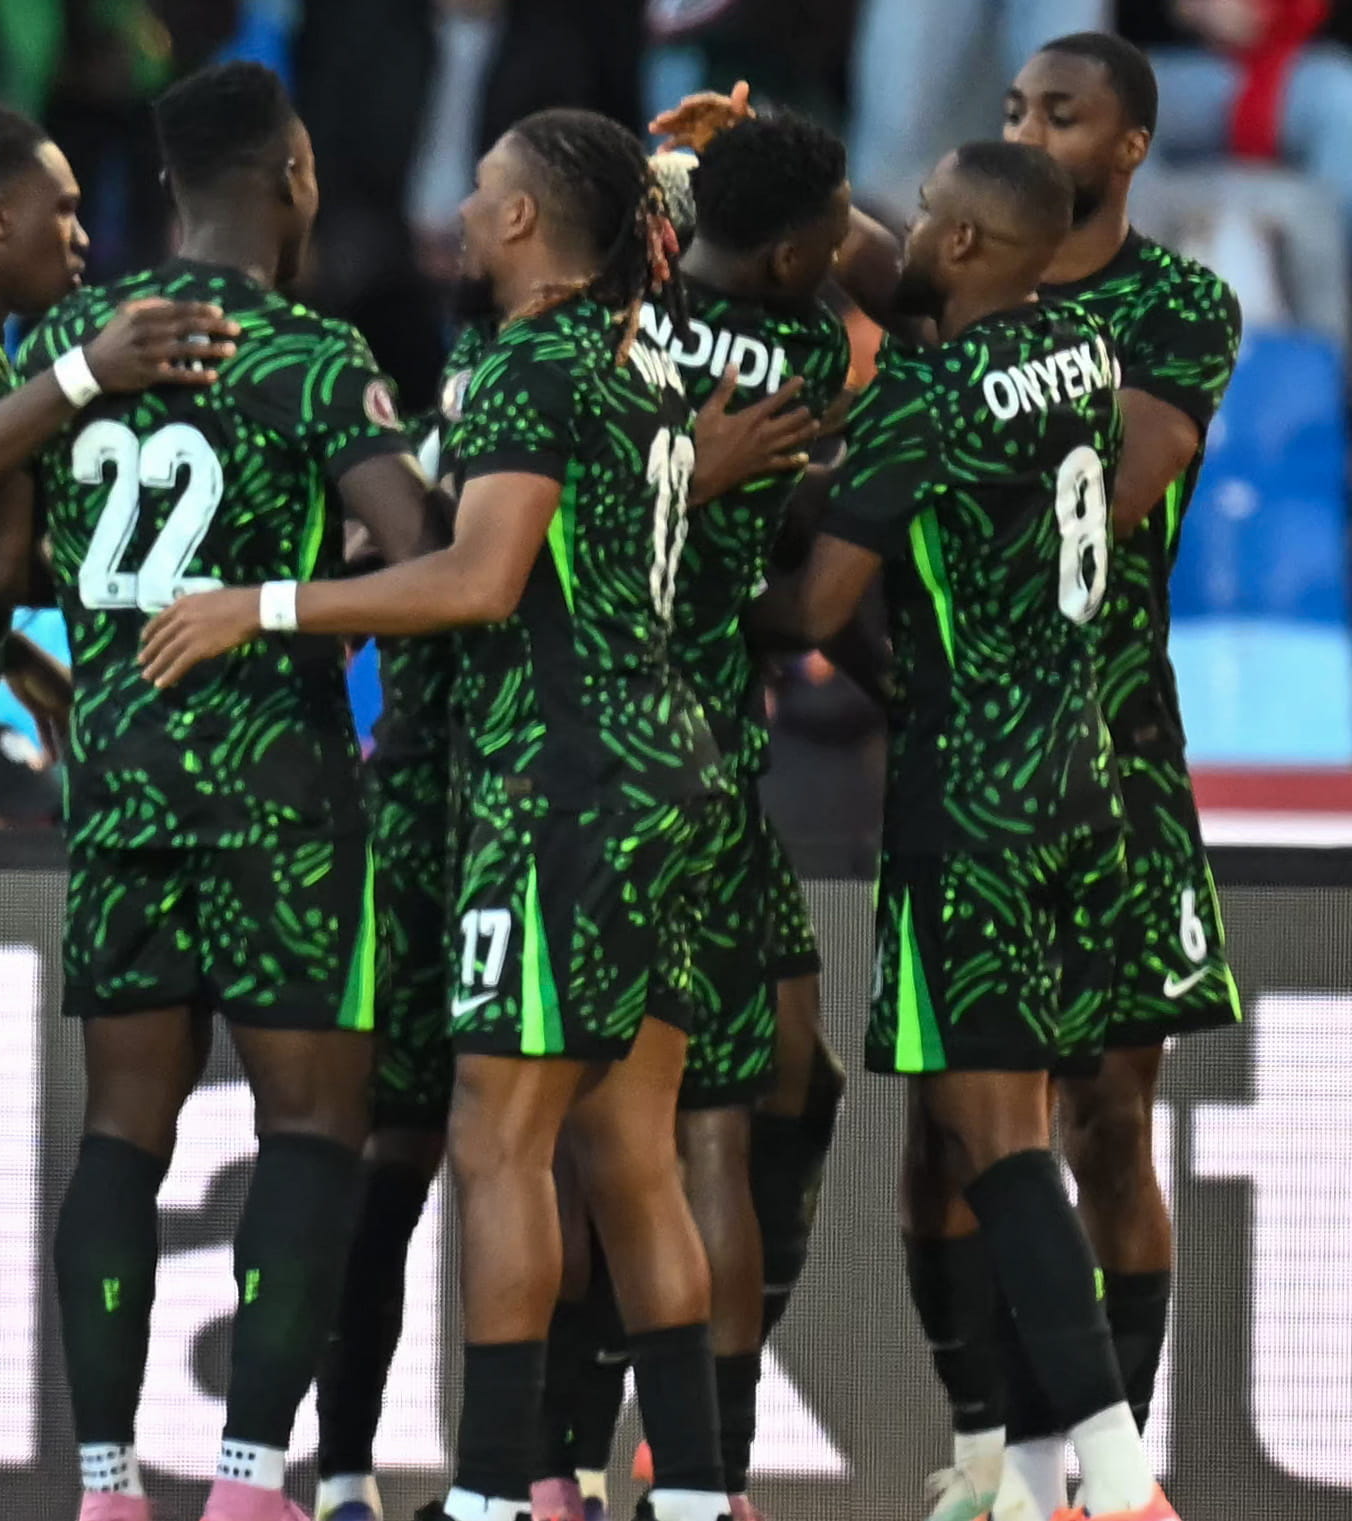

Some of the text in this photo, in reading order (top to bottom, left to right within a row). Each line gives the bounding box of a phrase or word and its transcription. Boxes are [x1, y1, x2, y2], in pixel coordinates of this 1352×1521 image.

[72, 418, 224, 613] 22
[1055, 445, 1108, 625] 8
[461, 908, 512, 988] 17
[1179, 888, 1208, 965] 6
